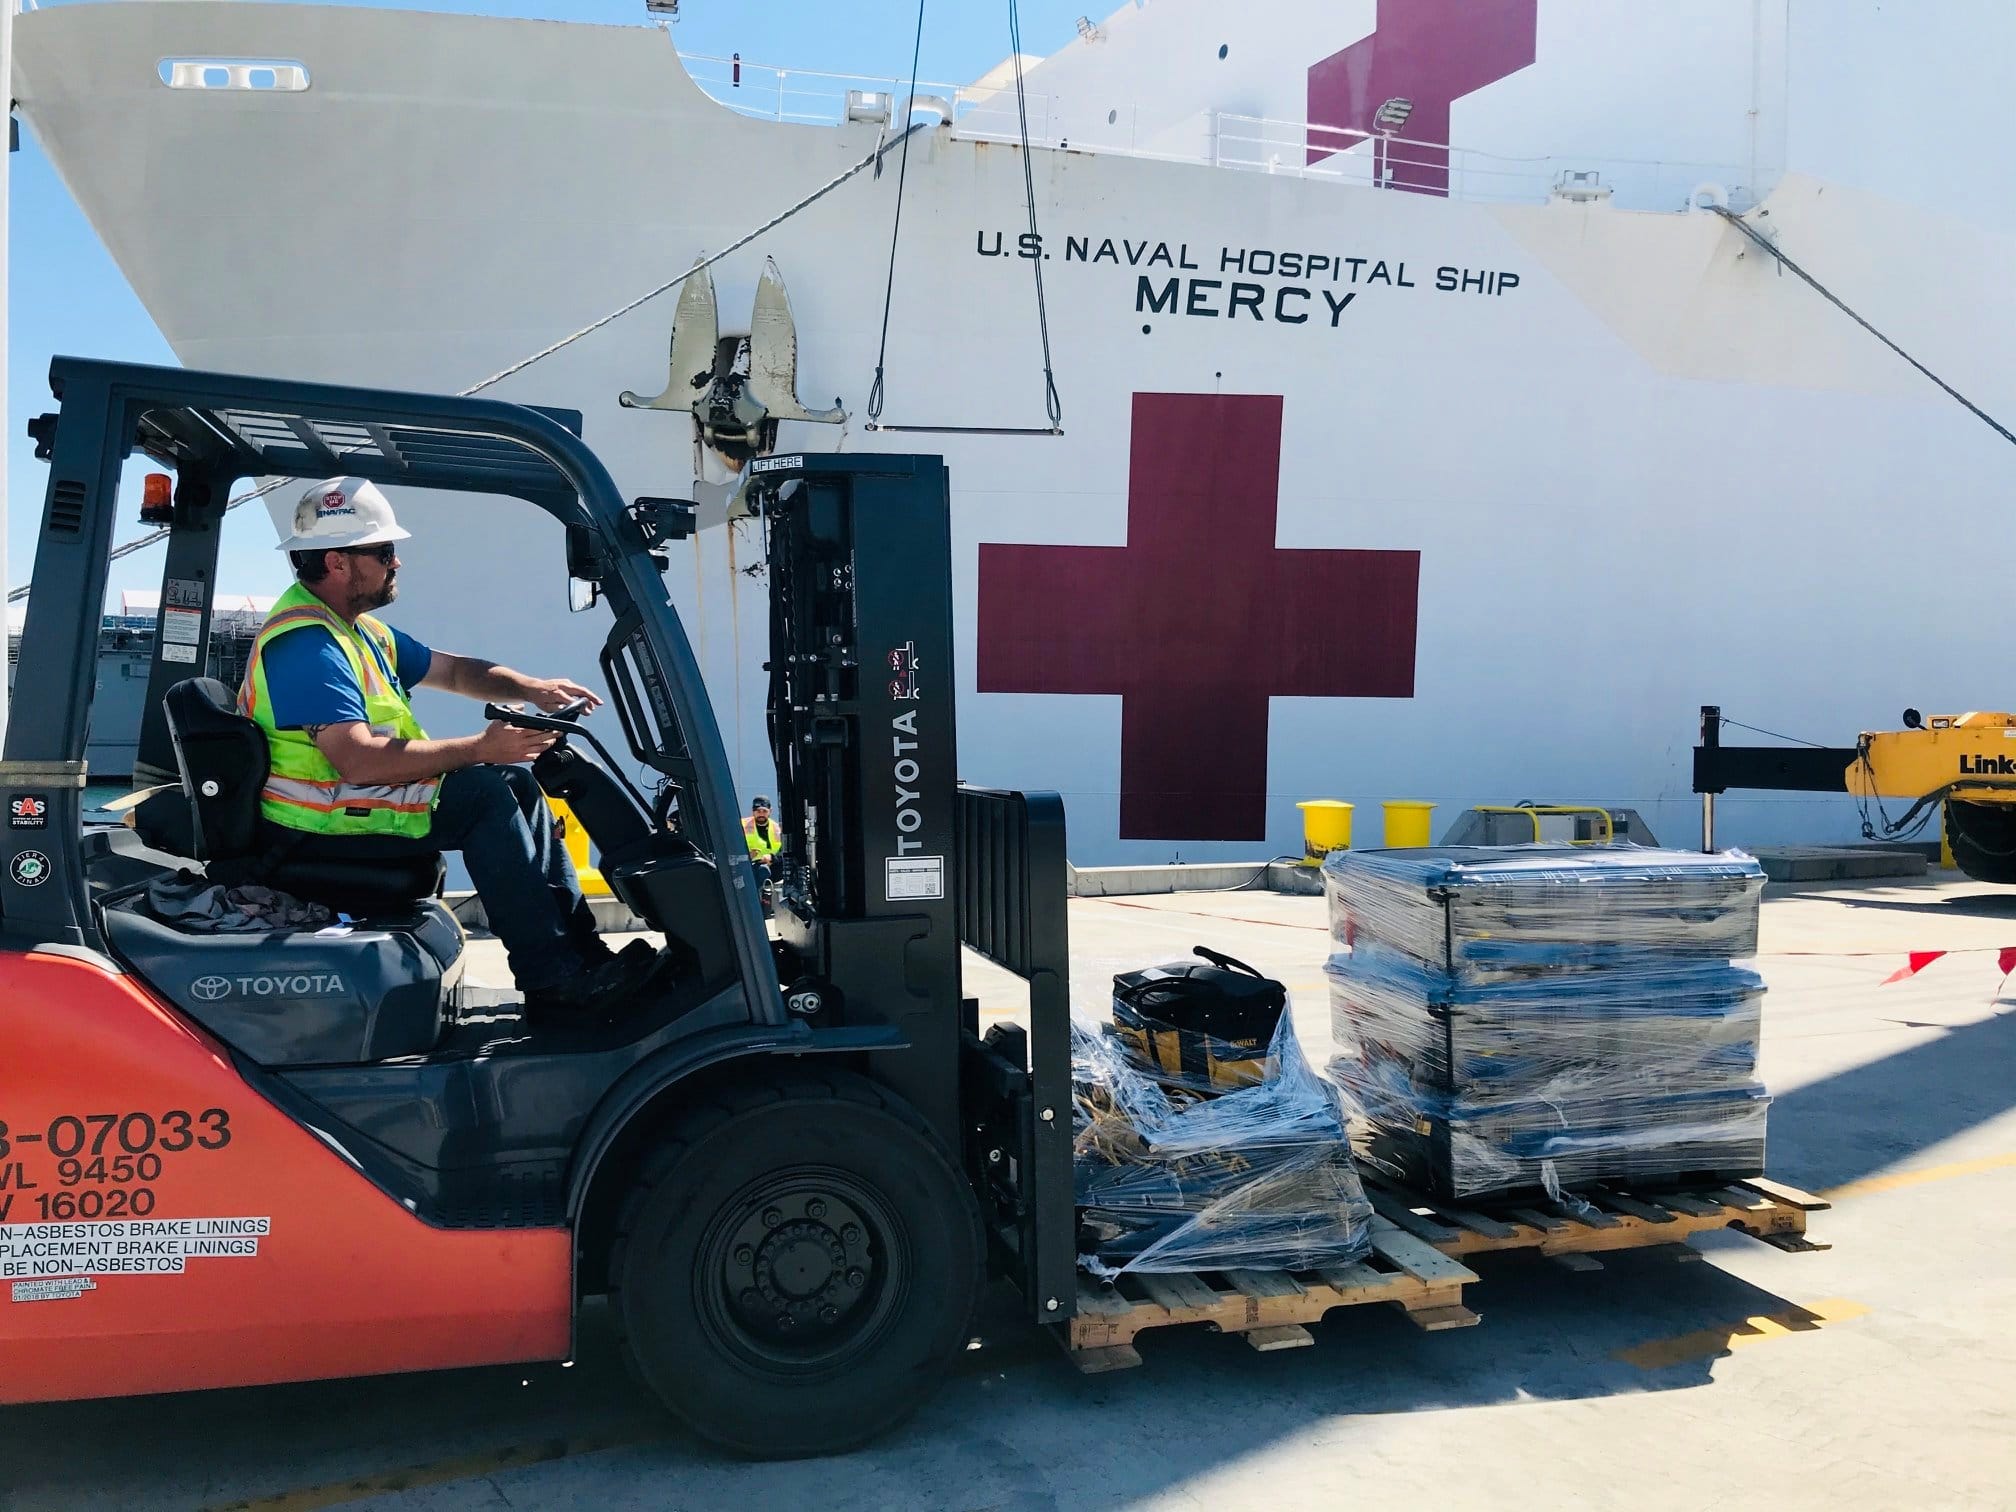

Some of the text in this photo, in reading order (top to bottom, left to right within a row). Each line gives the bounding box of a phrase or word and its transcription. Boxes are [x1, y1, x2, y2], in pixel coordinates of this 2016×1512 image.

[976, 230, 1520, 296] U.S. NAVAL HOSPITAL SHIP
[1135, 275, 1356, 328] MERCY
[754, 457, 801, 471] LIFT HERE
[892, 709, 923, 856] TOYOTA
[12, 798, 45, 815] SAS
[17, 875, 45, 884] FINAL
[236, 974, 345, 996] TOYOTA
[0, 1108, 232, 1160] -07033
[57, 1153, 163, 1187] 9450
[34, 1188, 156, 1220] 16020
[0, 1219, 268, 1241] N-ASBESTOS BRAKE LININGS
[117, 1240, 179, 1255] BRAKE
[183, 1239, 256, 1254] LININGS
[3, 1257, 183, 1276] BE NON-ASBESTOS
[45, 1279, 63, 1287] WITH
[54, 1284, 73, 1292] FREE
[52, 1290, 80, 1299] TOYOTA
